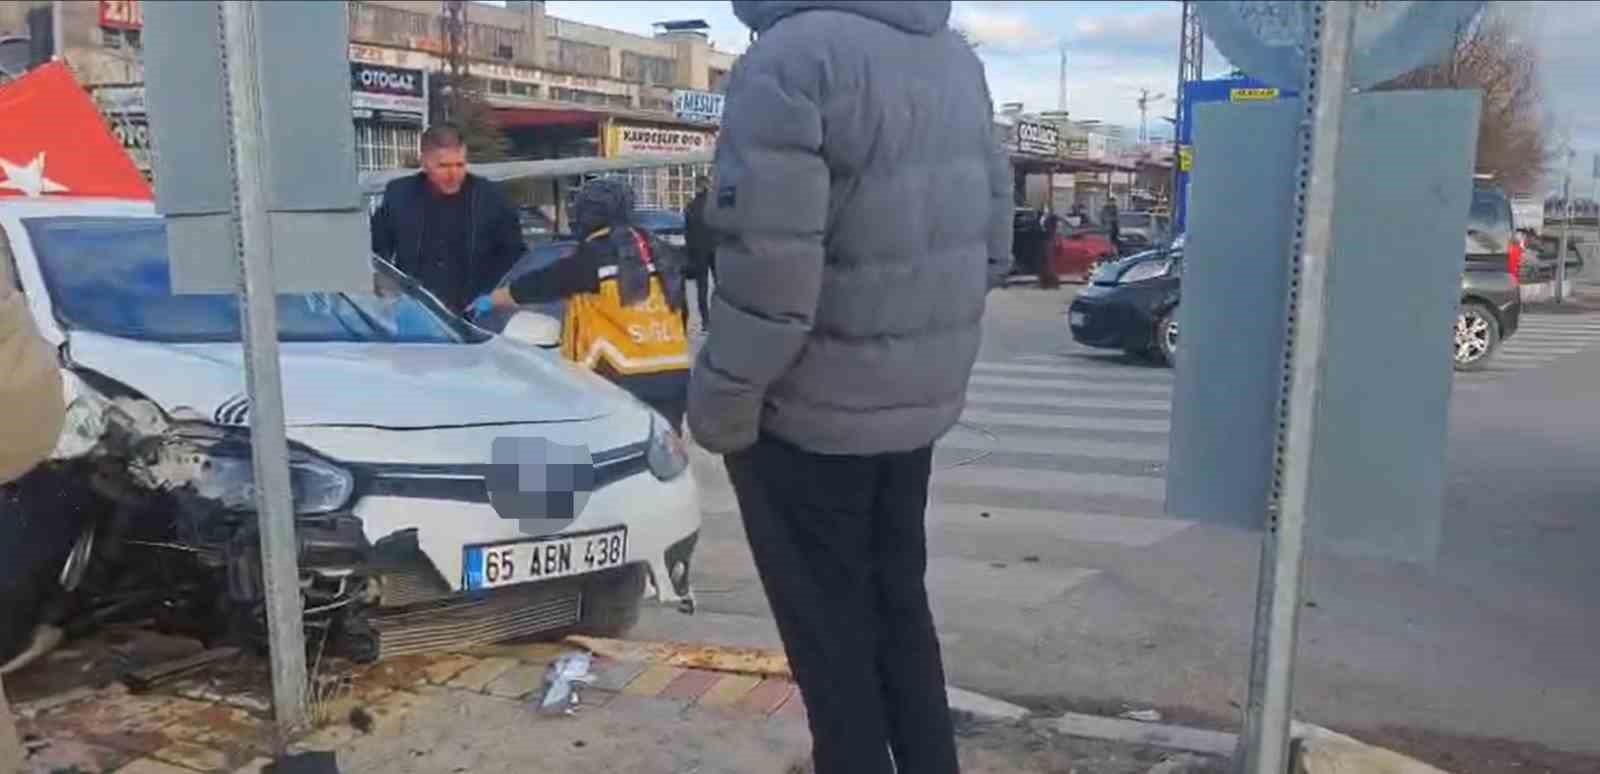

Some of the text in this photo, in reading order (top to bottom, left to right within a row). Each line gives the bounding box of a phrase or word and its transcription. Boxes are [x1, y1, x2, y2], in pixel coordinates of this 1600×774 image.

[361, 69, 414, 90] OTOGAZ
[683, 92, 721, 113] MESUT
[486, 550, 513, 582] 65
[531, 544, 571, 576] ABN
[584, 535, 620, 567] 438
